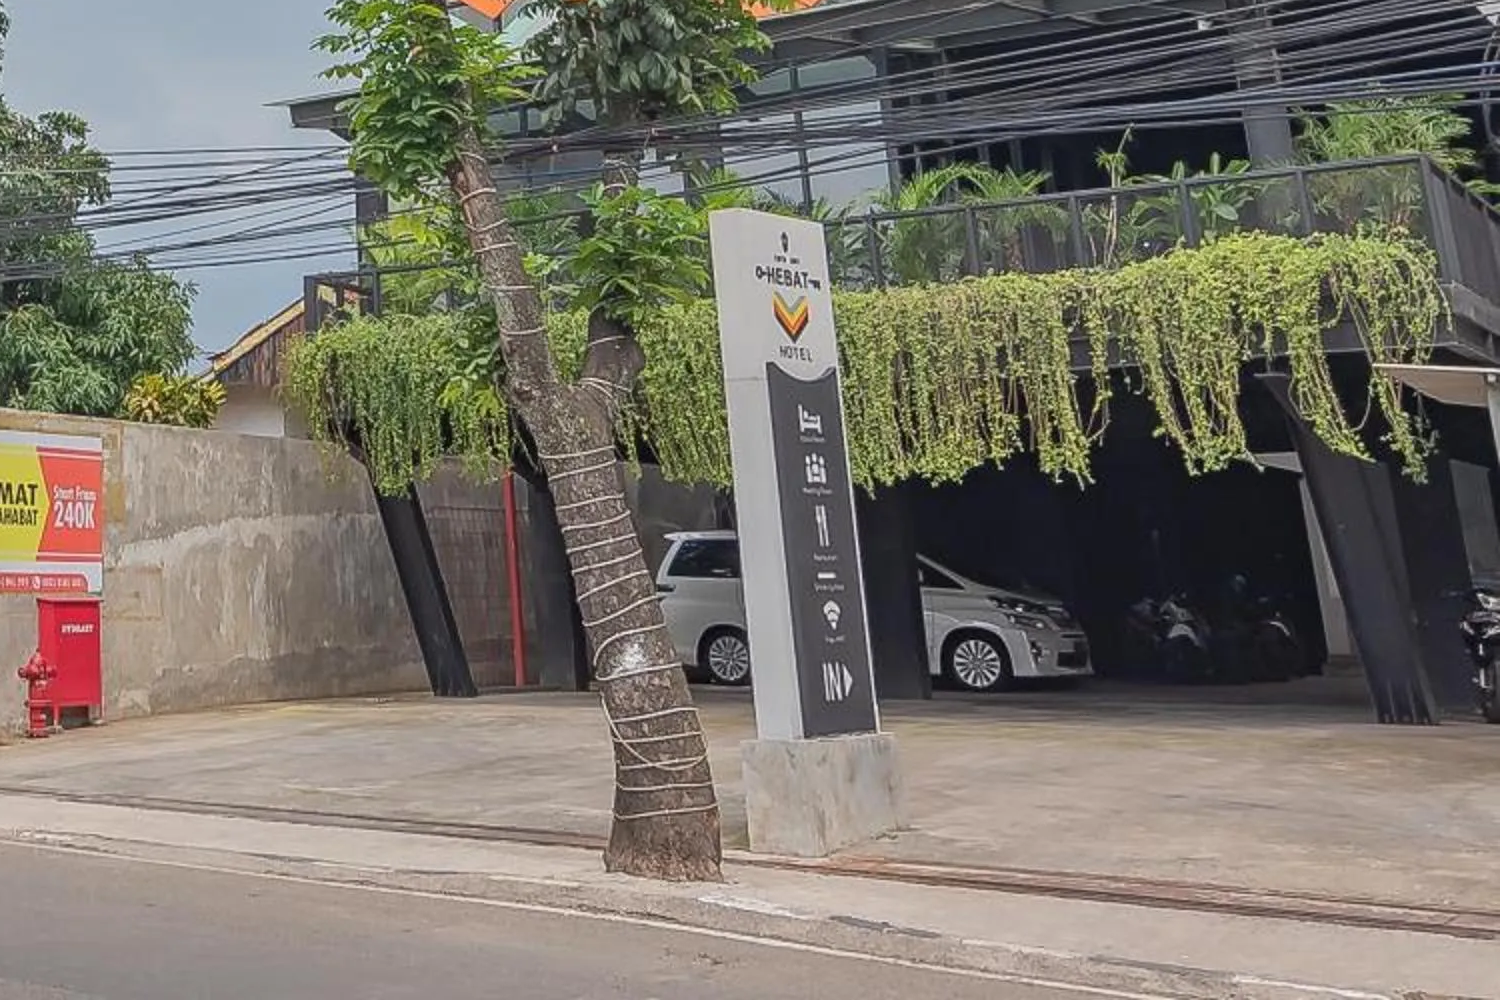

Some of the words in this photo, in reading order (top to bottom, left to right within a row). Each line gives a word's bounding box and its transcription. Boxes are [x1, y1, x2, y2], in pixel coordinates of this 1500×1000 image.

[766, 265, 809, 289] HEBAT
[780, 346, 813, 362] HOTEL
[53, 501, 95, 529] 240K
[822, 662, 843, 701] IN
